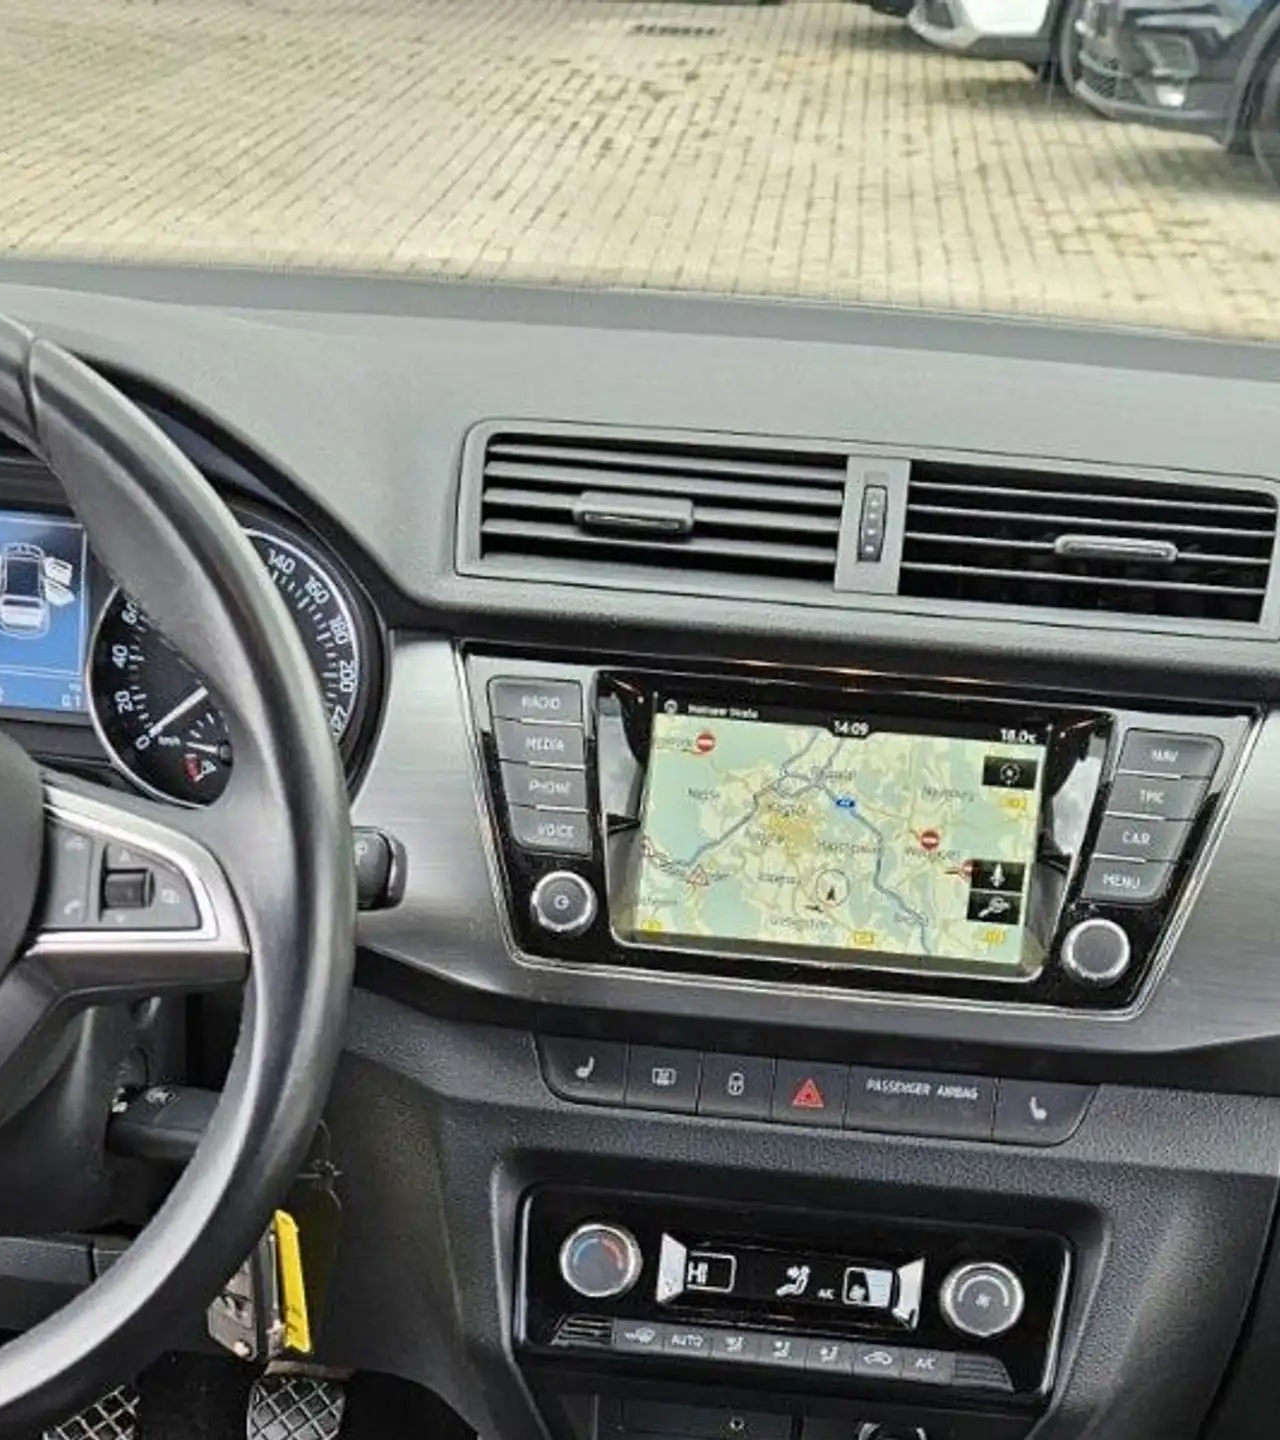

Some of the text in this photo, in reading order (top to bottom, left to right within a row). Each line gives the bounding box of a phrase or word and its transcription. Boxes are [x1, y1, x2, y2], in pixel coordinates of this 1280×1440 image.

[303, 574, 330, 604] 160
[329, 614, 350, 645] 180
[111, 643, 128, 669] 40
[339, 659, 356, 693] 200
[114, 690, 133, 714] 20
[521, 694, 562, 710] RADIO
[833, 719, 869, 736] 14:09
[135, 734, 151, 750] 0
[525, 736, 565, 752] MEDIA
[1151, 749, 1180, 763] NAV
[528, 779, 571, 795] PHONE
[537, 823, 575, 838] VOICE
[1122, 830, 1151, 845] CAR
[1102, 872, 1142, 890] MENU
[865, 1078, 979, 1100] PASSENGER AIRBAG
[671, 1335, 705, 1348] AUTO
